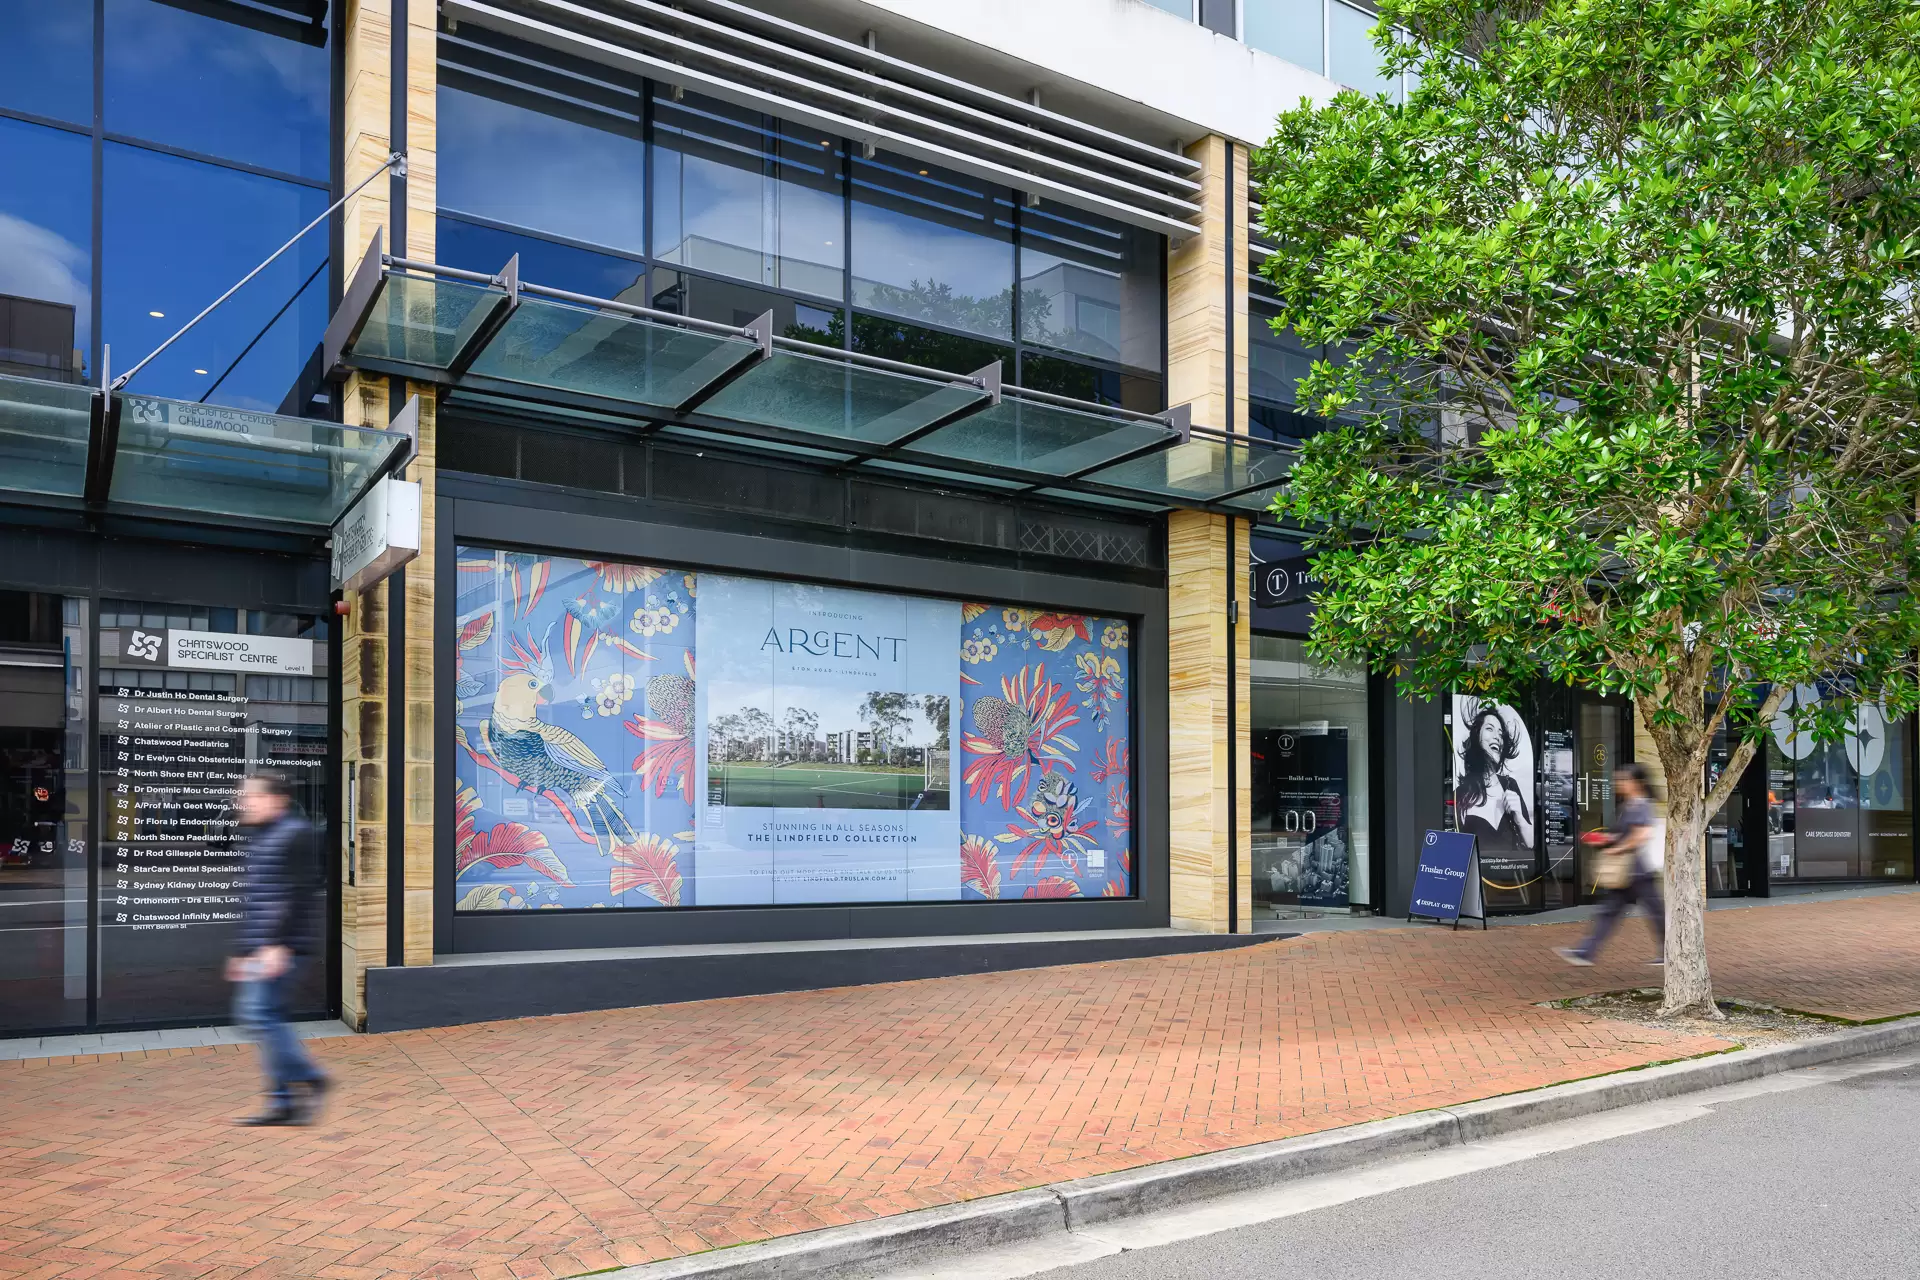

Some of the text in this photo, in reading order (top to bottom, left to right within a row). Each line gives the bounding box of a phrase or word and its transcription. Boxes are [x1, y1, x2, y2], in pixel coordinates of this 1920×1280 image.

[809, 611, 863, 620] INTRODUCING
[178, 639, 248, 651] CHATSWOOD
[761, 627, 906, 662] ARGENT
[178, 650, 278, 664] SPECIALIST CENTRE
[217, 695, 248, 703] Surgery
[216, 710, 248, 718] Surgery
[262, 727, 292, 736] Surgery
[134, 738, 229, 748] Chatswood Paediatrics
[147, 755, 175, 763] Evelyn
[266, 758, 321, 767] Gynaecologist
[206, 772, 224, 780] (Ear,
[203, 787, 247, 796] Cardiology
[180, 818, 239, 827] Endocrinology
[229, 834, 252, 843] Allerg
[165, 850, 201, 858] Gillespie
[1420, 864, 1465, 878] Truslan Group
[134, 881, 164, 890] Sydney
[198, 881, 230, 889] Urology
[1421, 900, 1440, 908] DISPLAY
[133, 913, 180, 921] Chatswood
[182, 912, 210, 920] Infinity
